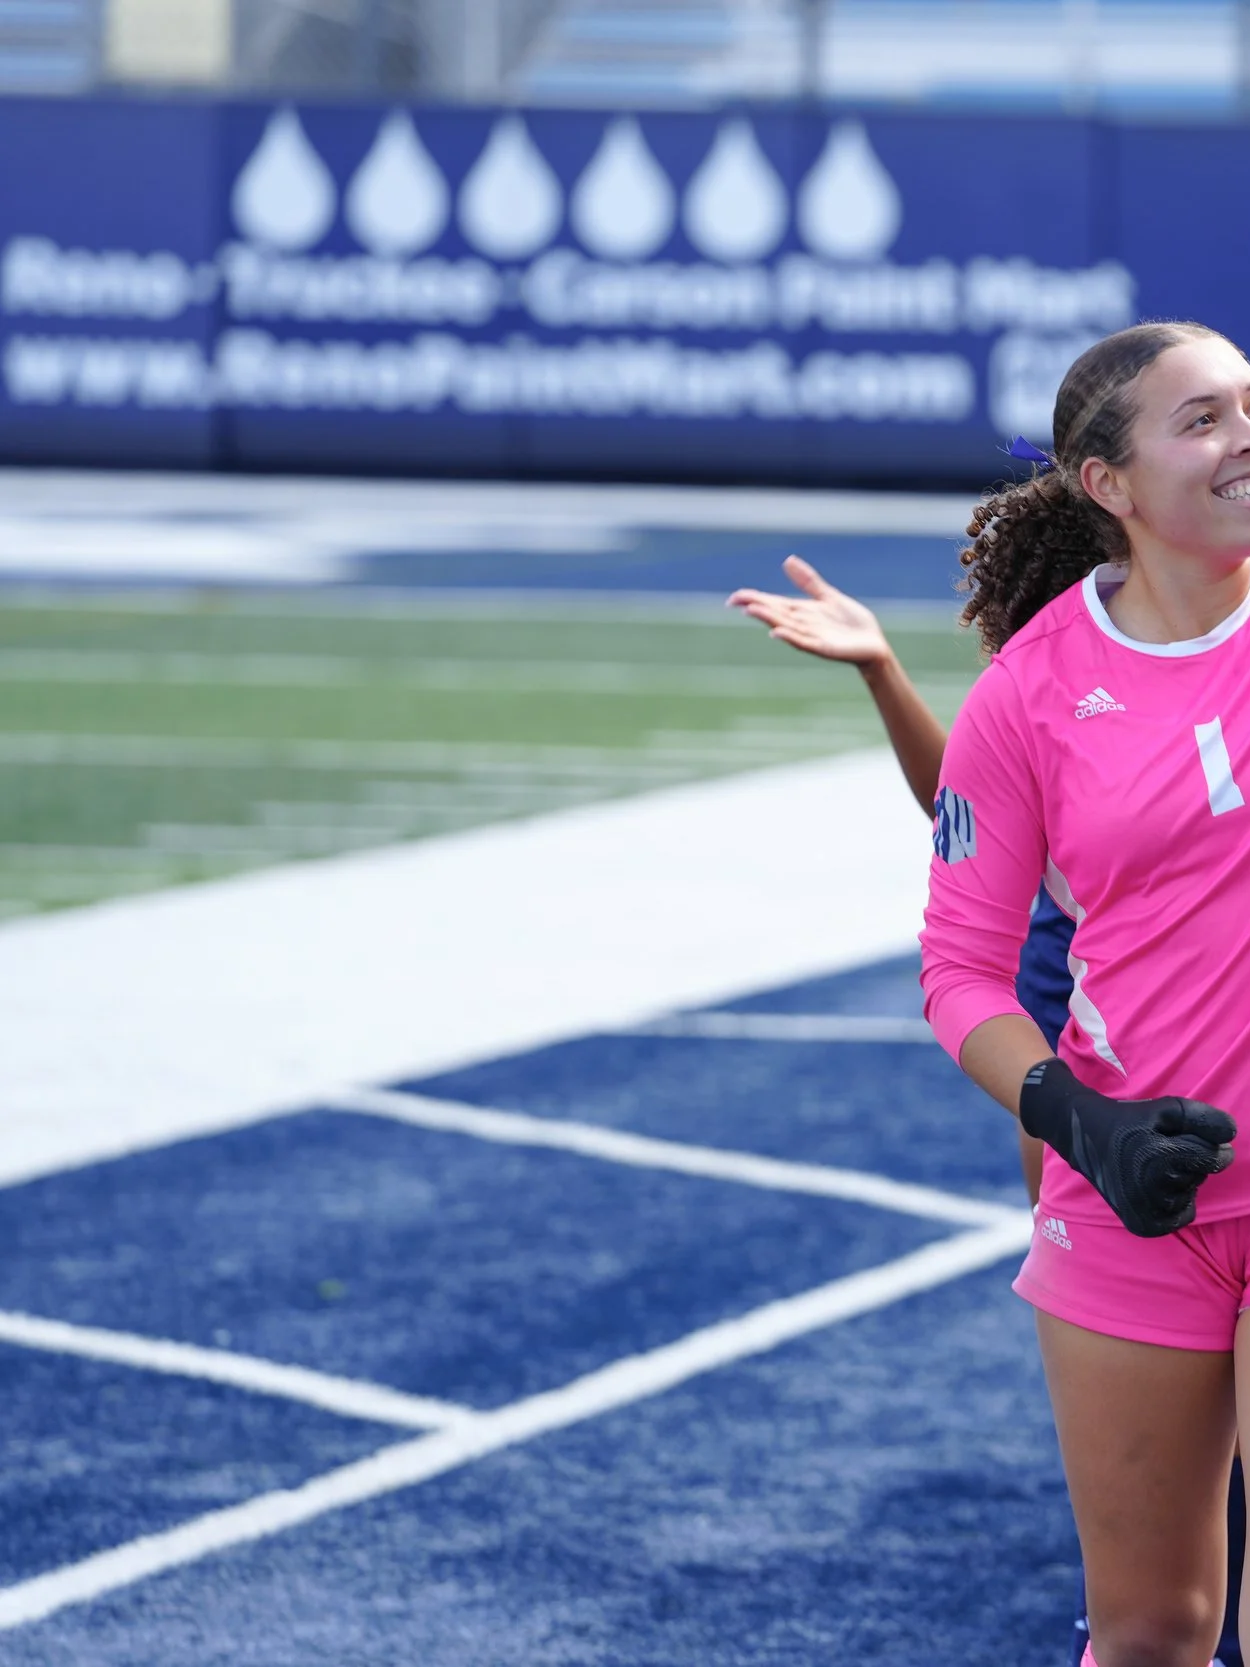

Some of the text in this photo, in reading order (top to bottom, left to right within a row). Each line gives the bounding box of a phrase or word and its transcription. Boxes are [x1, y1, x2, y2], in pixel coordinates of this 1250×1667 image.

[781, 257, 958, 332] Paint
[965, 259, 1136, 336] Mart
[1074, 700, 1127, 720] adidas
[1194, 715, 1245, 816] 1
[1041, 1226, 1073, 1251] adidas
